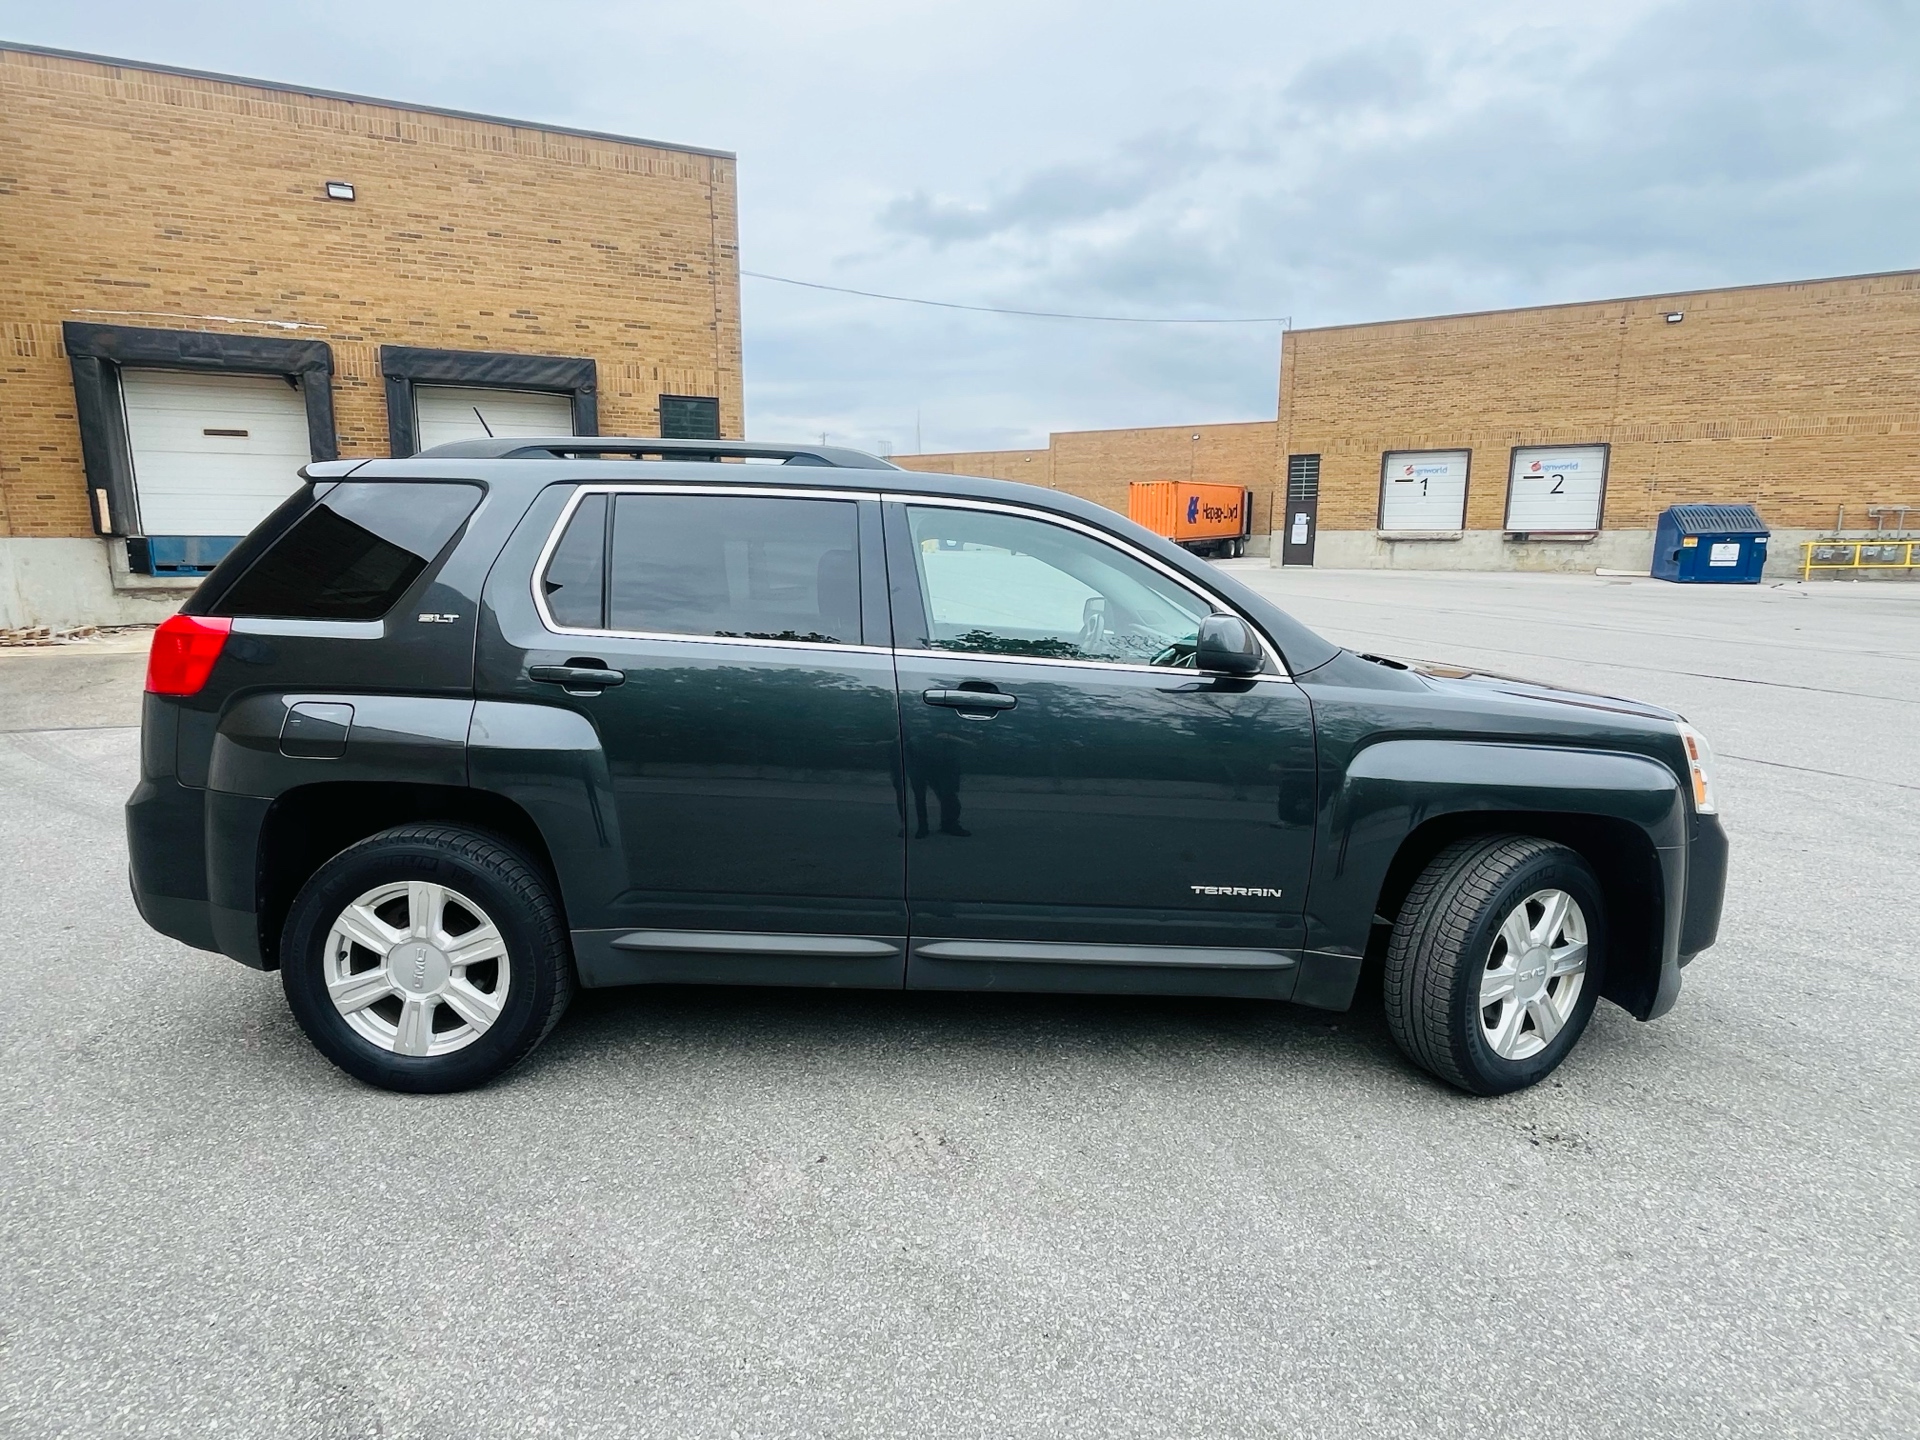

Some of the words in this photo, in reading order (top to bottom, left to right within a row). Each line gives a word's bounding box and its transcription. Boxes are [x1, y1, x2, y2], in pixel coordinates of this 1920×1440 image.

[1420, 478, 1428, 496] 1
[1550, 474, 1564, 494] 2
[418, 613, 460, 623] SLT
[1190, 885, 1282, 898] TERRAIN
[413, 947, 427, 989] GMC
[1519, 965, 1545, 982] GMC
